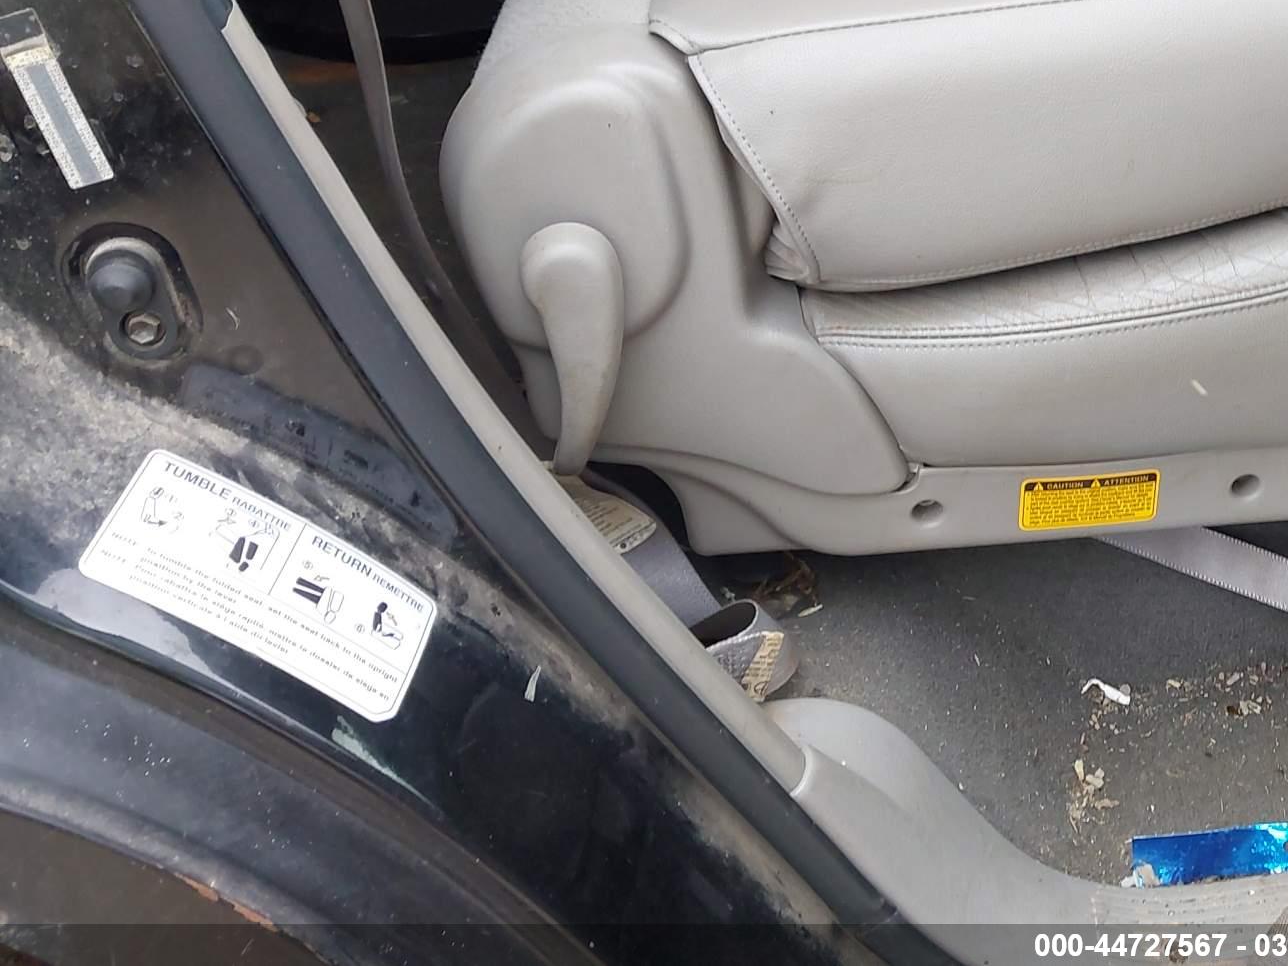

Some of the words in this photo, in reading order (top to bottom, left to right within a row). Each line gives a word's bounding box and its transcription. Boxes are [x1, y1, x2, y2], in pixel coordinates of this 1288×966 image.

[164, 461, 231, 501] TUMBLE
[232, 497, 292, 532] RABATTRE
[1046, 481, 1084, 490] CAUTION
[1103, 475, 1150, 486] ATTENTION
[196, 582, 212, 591] the
[311, 536, 372, 577] RETURN
[372, 575, 424, 612] REMETTRE
[194, 570, 209, 578] the
[211, 578, 241, 594] folded
[267, 605, 282, 616] set
[283, 615, 298, 623] the
[300, 624, 319, 634] seat
[320, 634, 341, 646] back
[341, 644, 352, 655] to
[352, 651, 367, 664] the
[367, 663, 399, 682] upright
